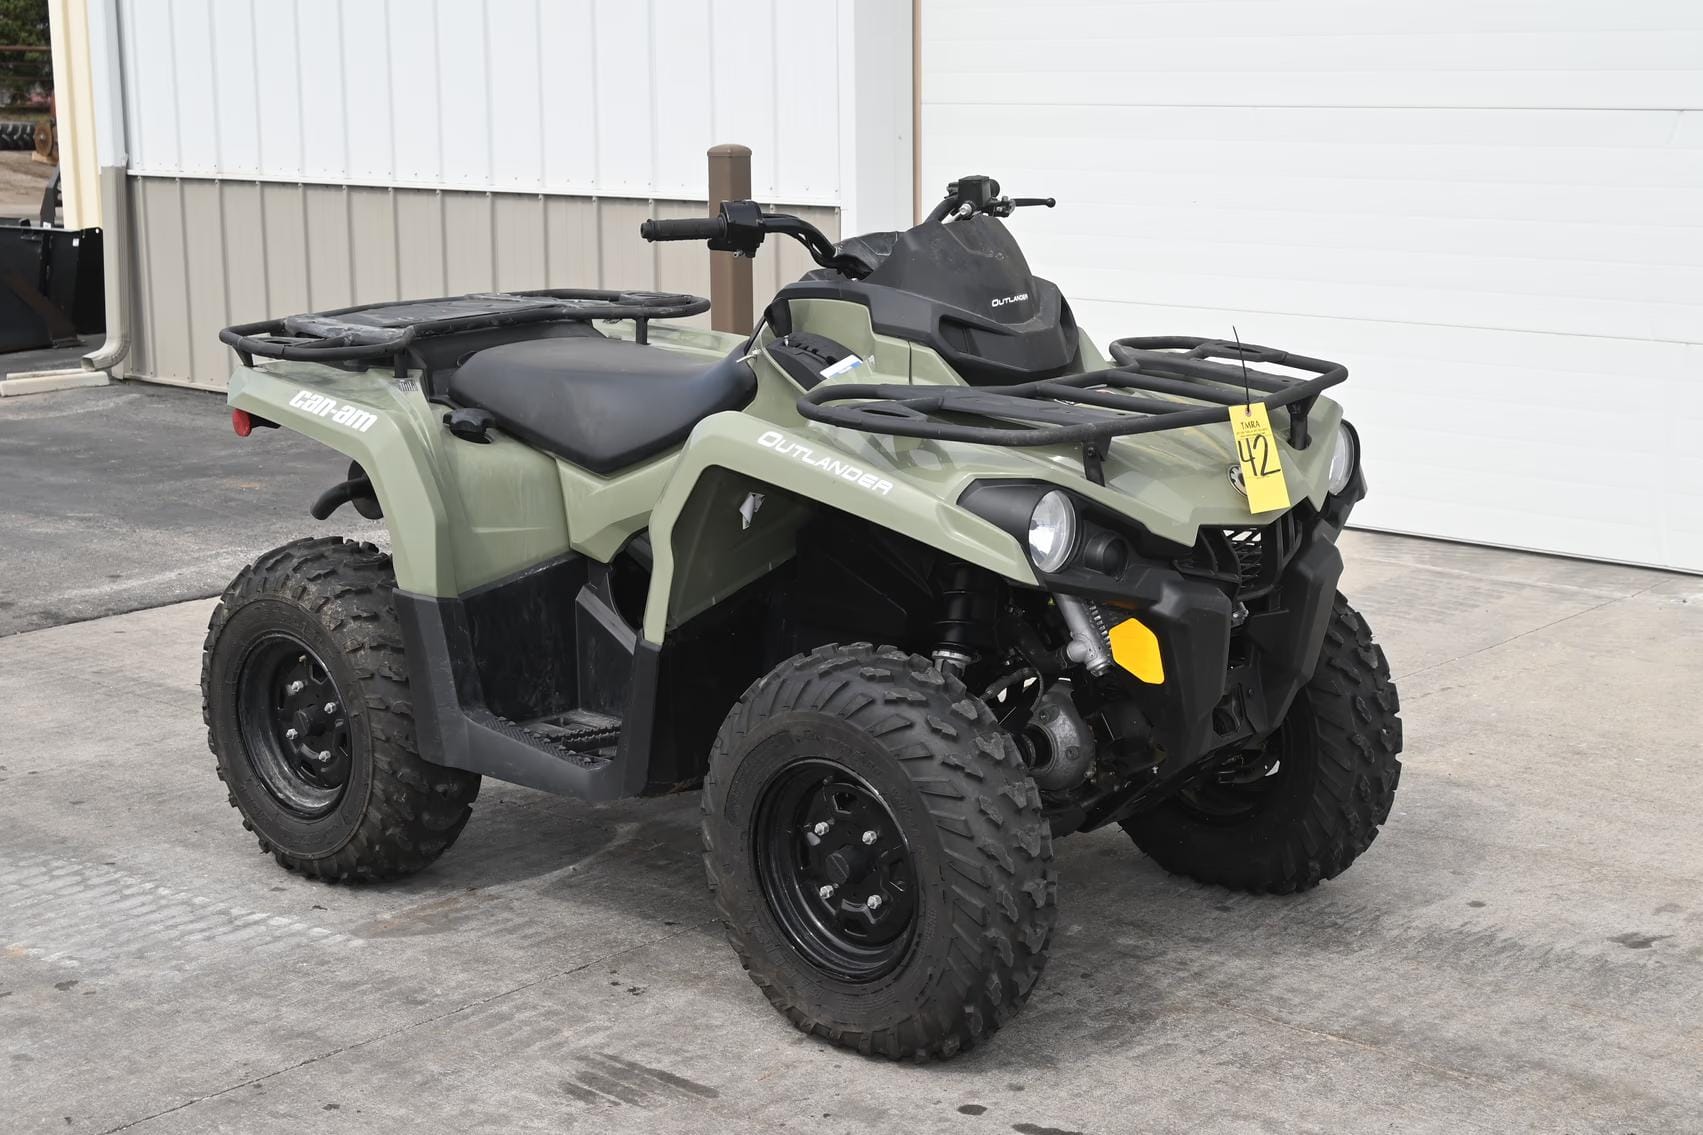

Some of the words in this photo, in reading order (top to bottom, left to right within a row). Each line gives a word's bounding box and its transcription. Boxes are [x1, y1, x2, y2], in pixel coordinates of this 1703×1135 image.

[288, 390, 378, 432] can-am
[757, 430, 894, 496] OUTLANDER
[1238, 434, 1281, 477] 42
